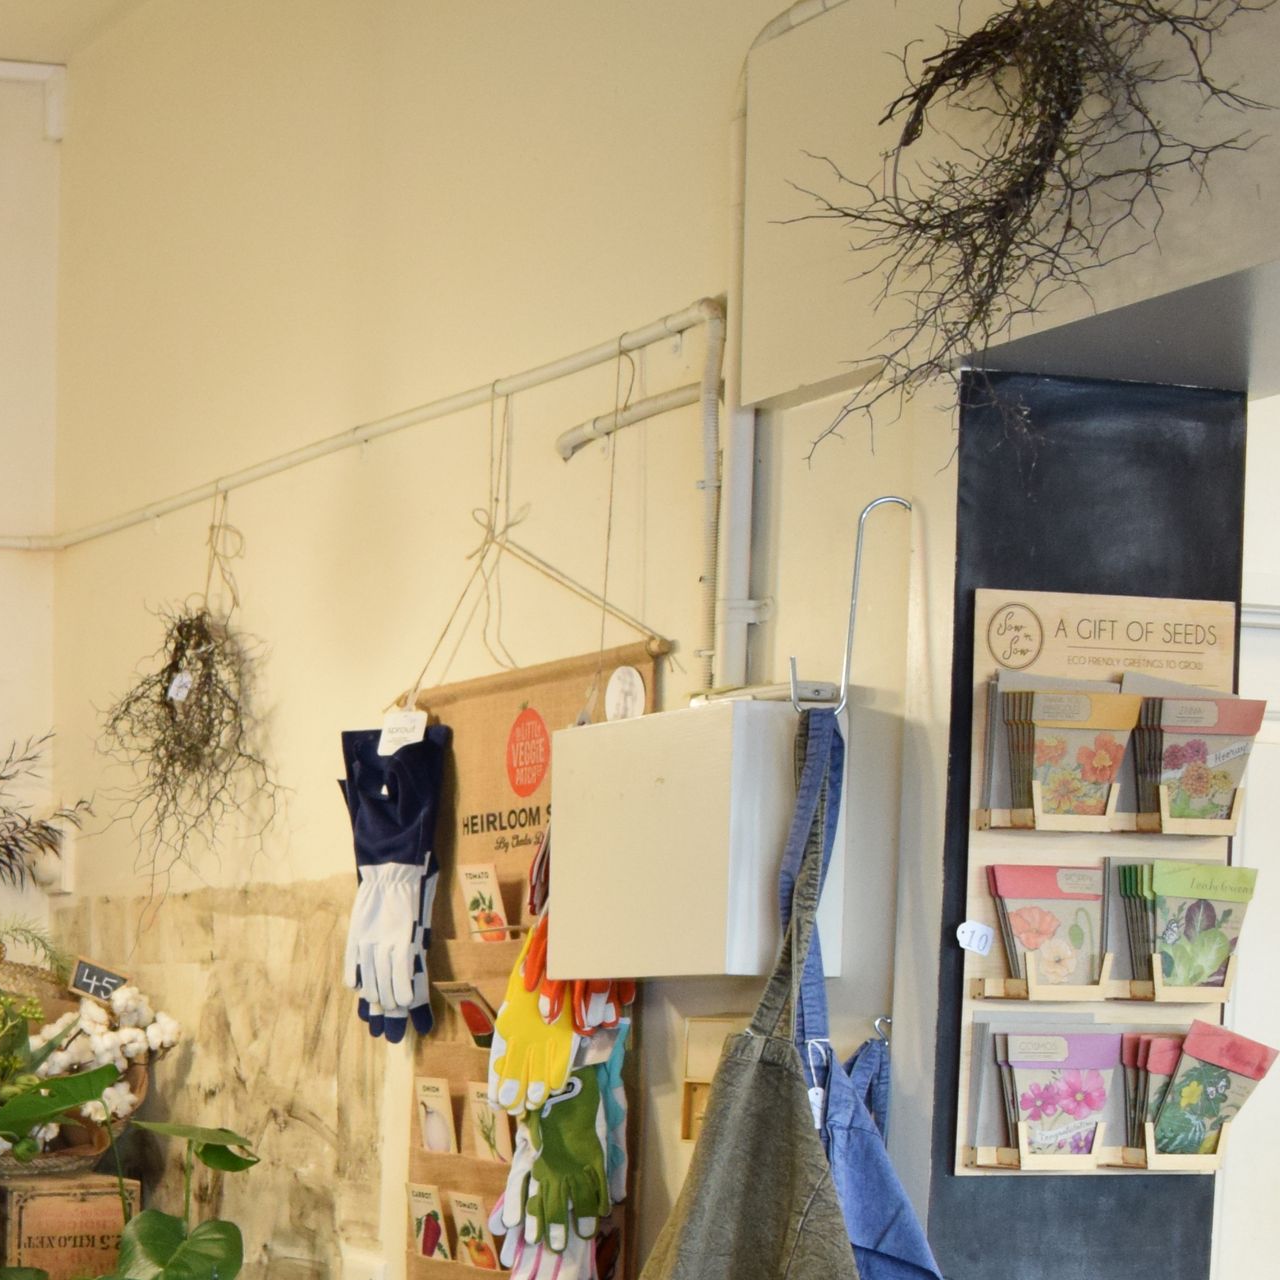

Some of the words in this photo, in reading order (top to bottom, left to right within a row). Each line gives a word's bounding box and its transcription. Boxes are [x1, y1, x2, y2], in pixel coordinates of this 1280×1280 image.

[1055, 618, 1068, 639] A
[1077, 618, 1118, 641] GIFT
[1126, 620, 1154, 643] OF
[1162, 622, 1218, 646] SEEDS
[1067, 655, 1086, 666] ECO
[1088, 656, 1121, 667] FRIENDLY
[1122, 657, 1165, 669] GREETINGS
[1166, 659, 1178, 670] TO
[1178, 659, 1204, 671] GROW
[511, 737, 545, 768] VEGGIE
[462, 806, 541, 836] HEIRLOOM
[494, 835, 509, 853] By
[465, 871, 490, 881] TOMATO
[966, 929, 989, 951] 10
[82, 968, 118, 1000] 45
[455, 1199, 478, 1211] TOMATO
